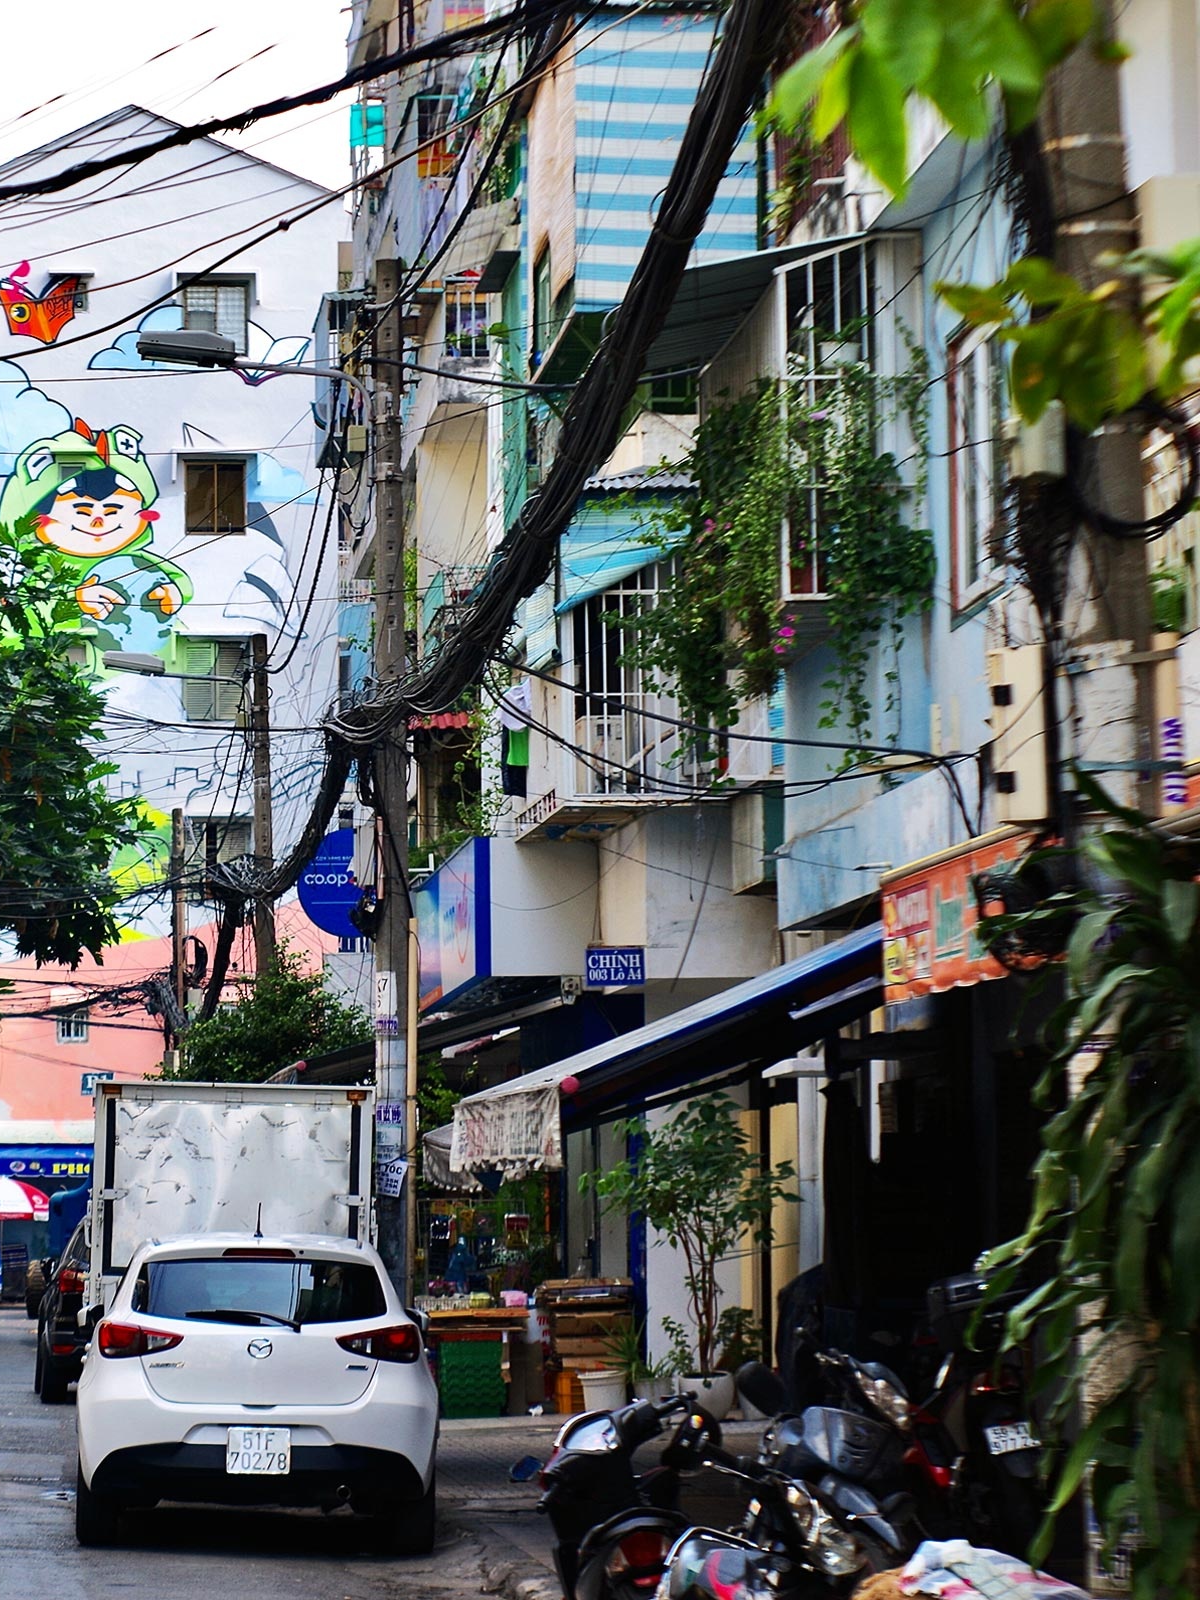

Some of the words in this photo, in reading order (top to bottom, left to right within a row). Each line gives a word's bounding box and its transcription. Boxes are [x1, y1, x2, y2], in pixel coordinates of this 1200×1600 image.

[304, 873, 348, 887] co.op
[588, 950, 641, 968] CHÍNH
[589, 969, 608, 981] 003
[627, 968, 642, 980] A4
[243, 1432, 275, 1450] 51F
[230, 1451, 287, 1471] 702.78
